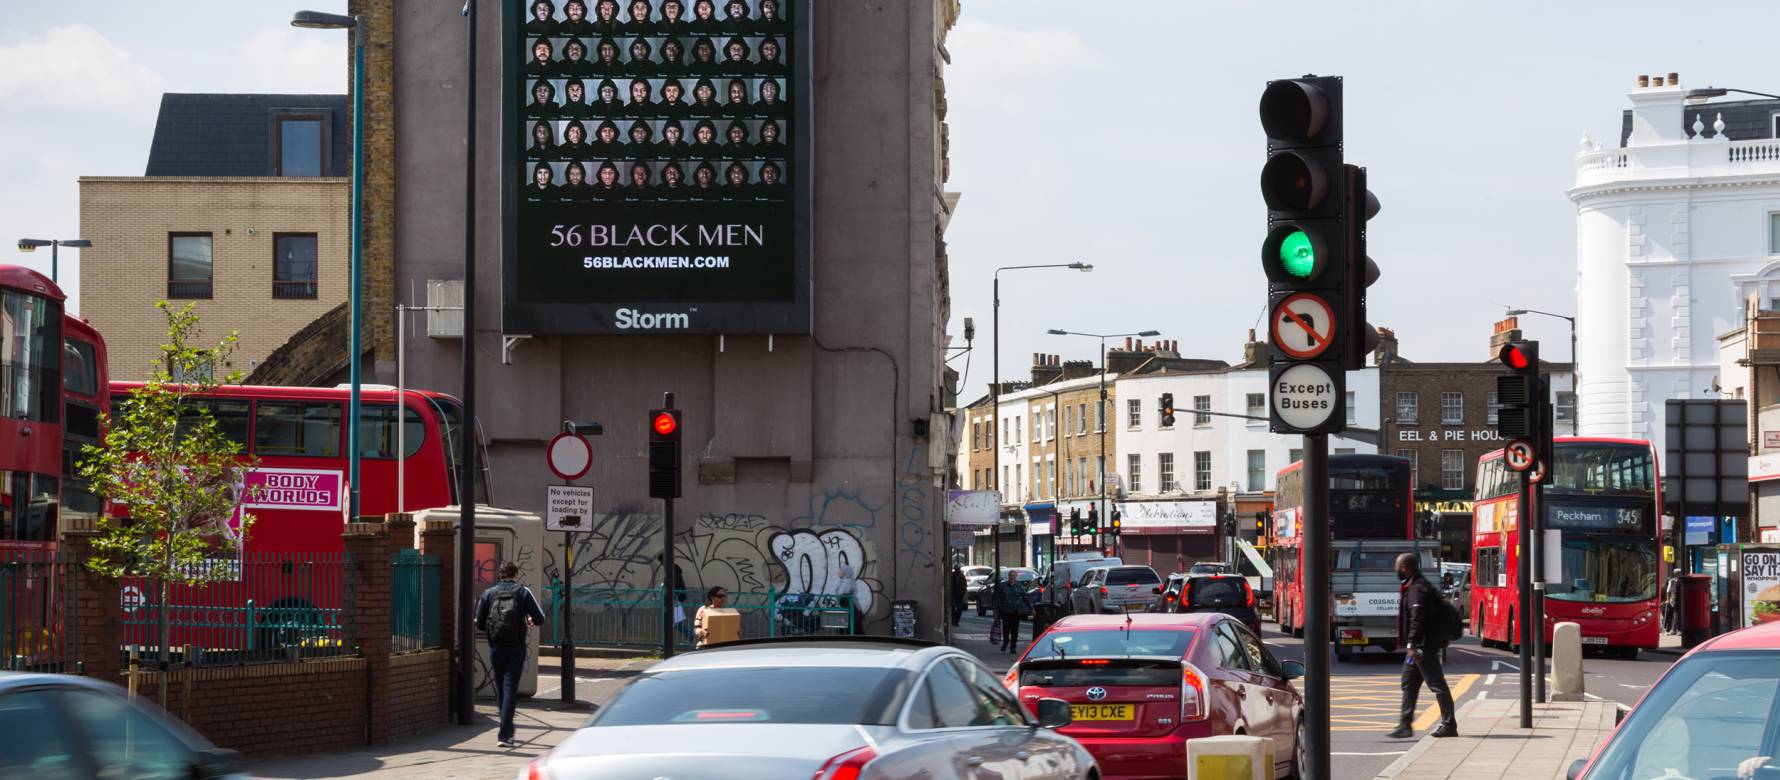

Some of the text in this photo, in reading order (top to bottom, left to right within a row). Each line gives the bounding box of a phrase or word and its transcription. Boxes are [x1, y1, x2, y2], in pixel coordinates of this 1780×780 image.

[550, 224, 763, 247] 56 BLACK MEN
[583, 256, 730, 268] 56BLACKMEN.COM
[614, 308, 689, 329] Storm
[1279, 382, 1331, 396] Except
[1281, 398, 1328, 409] Buses
[1399, 430, 1504, 441] EEL & PIE HOU
[266, 474, 320, 490] BODY
[252, 489, 330, 505] WORLDS
[563, 489, 591, 497] vehicles
[578, 498, 588, 506] for
[551, 505, 588, 515] loading by
[1557, 509, 1638, 525] Peckham 345
[1744, 554, 1780, 566] GO ON.
[1744, 565, 1780, 577] SAY IT.
[1071, 705, 1126, 718] EY13 CXE
